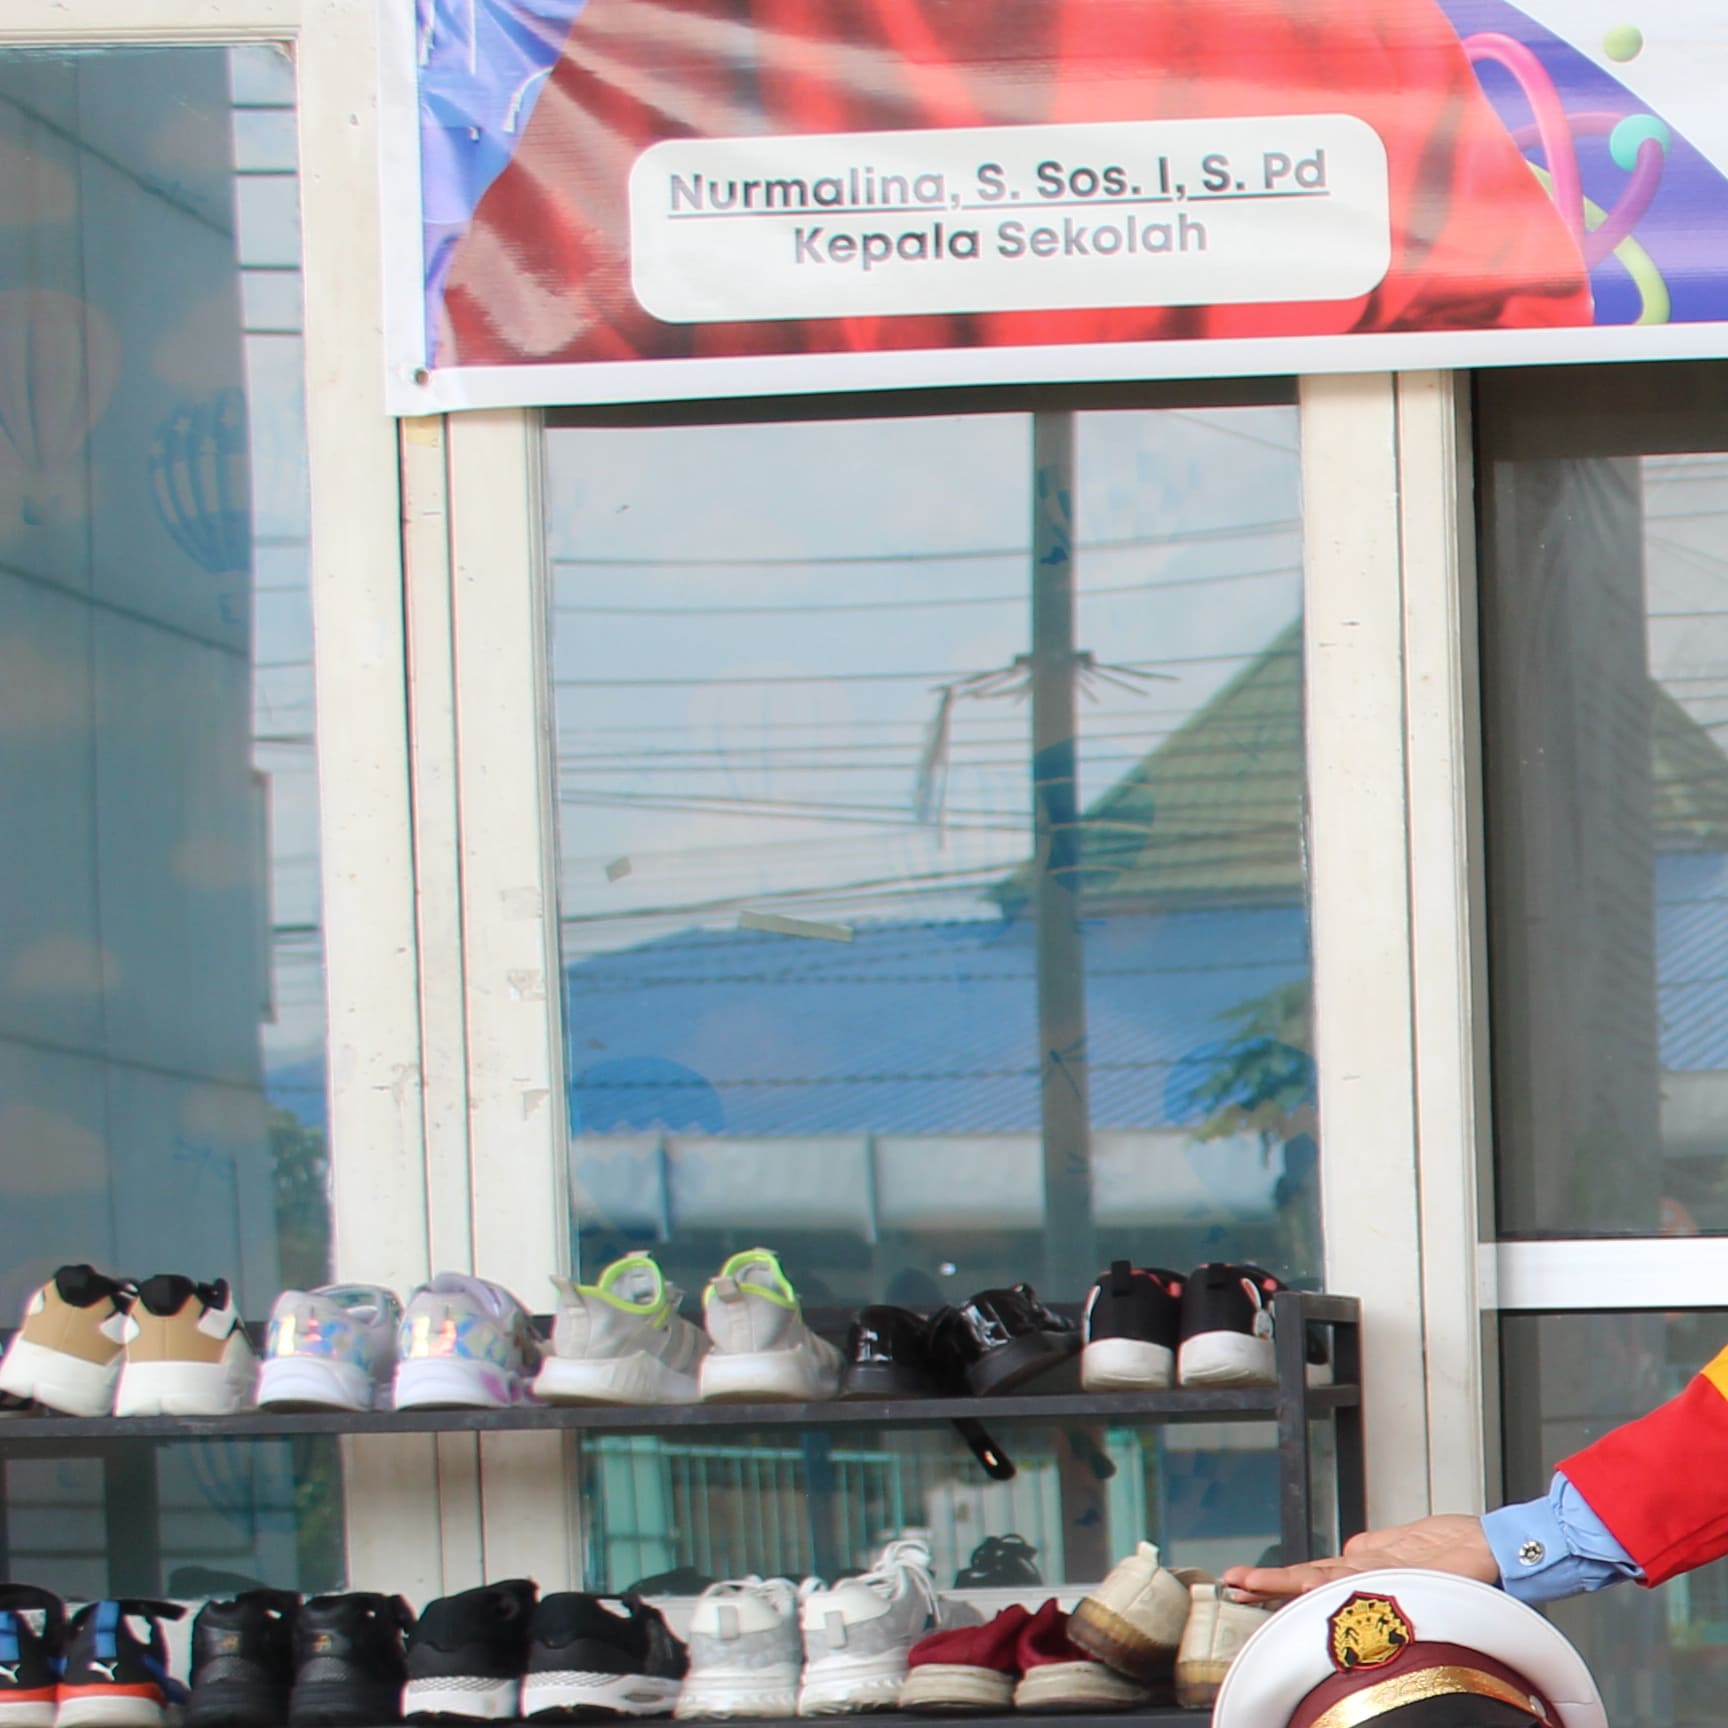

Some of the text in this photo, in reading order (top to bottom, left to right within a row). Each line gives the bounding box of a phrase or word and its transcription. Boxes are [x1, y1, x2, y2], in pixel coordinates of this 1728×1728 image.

[668, 165, 964, 212] Nurmalina,
[976, 160, 1022, 204] S.
[1036, 155, 1142, 202] Sos.
[1200, 153, 1246, 195] S.
[1263, 148, 1328, 192] Pd
[793, 214, 1208, 272] Kepala Sekolah
